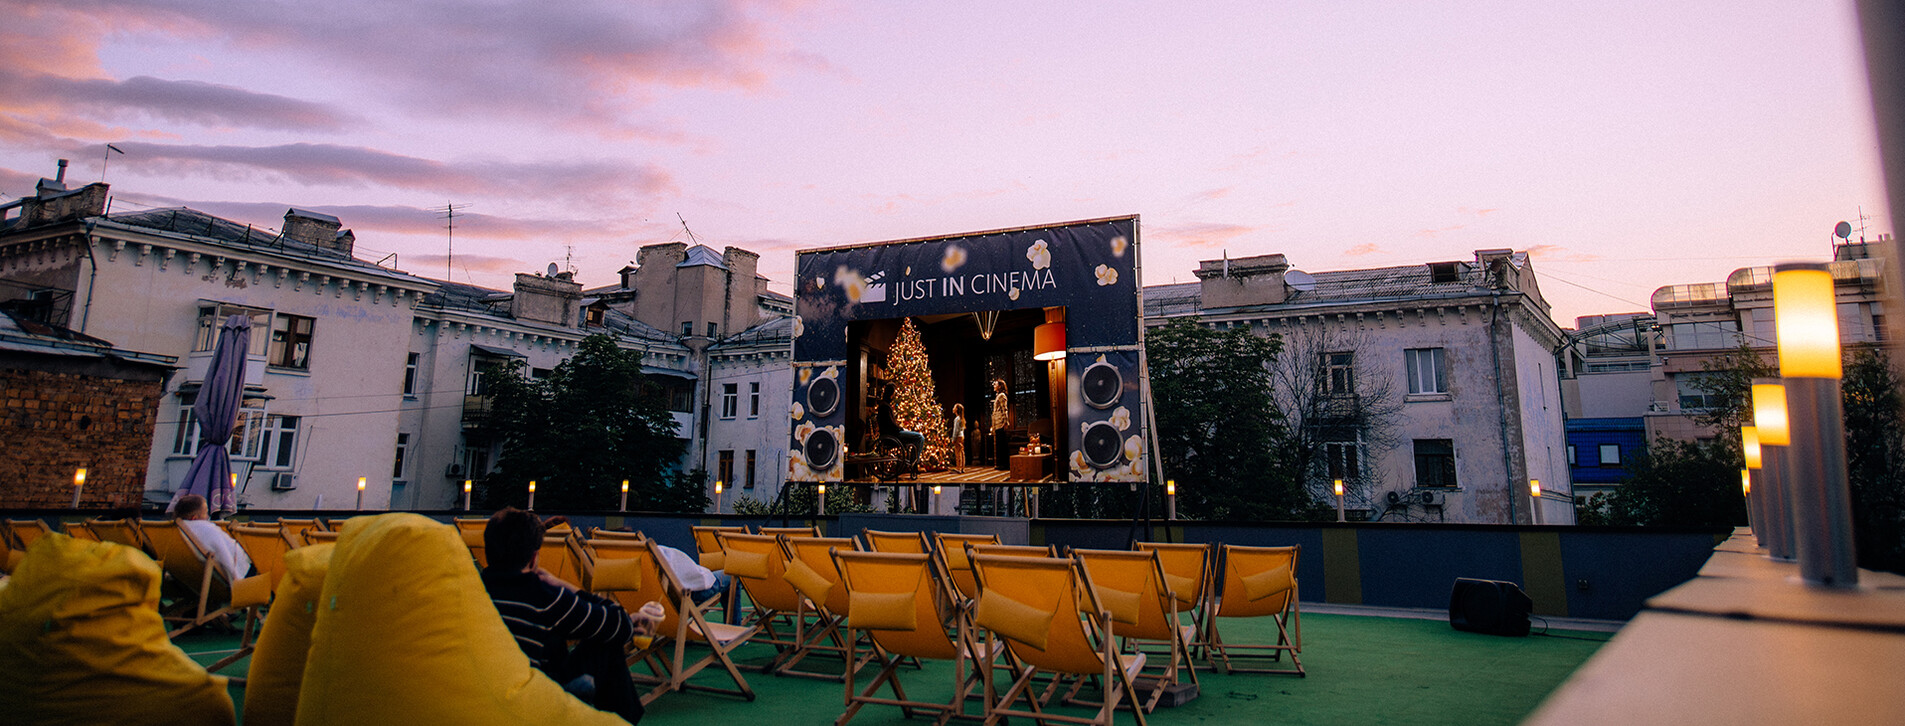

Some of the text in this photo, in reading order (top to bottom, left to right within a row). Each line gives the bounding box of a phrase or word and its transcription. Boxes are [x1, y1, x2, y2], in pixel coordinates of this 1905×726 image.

[893, 269, 1056, 305] JUST IN CINEMA
